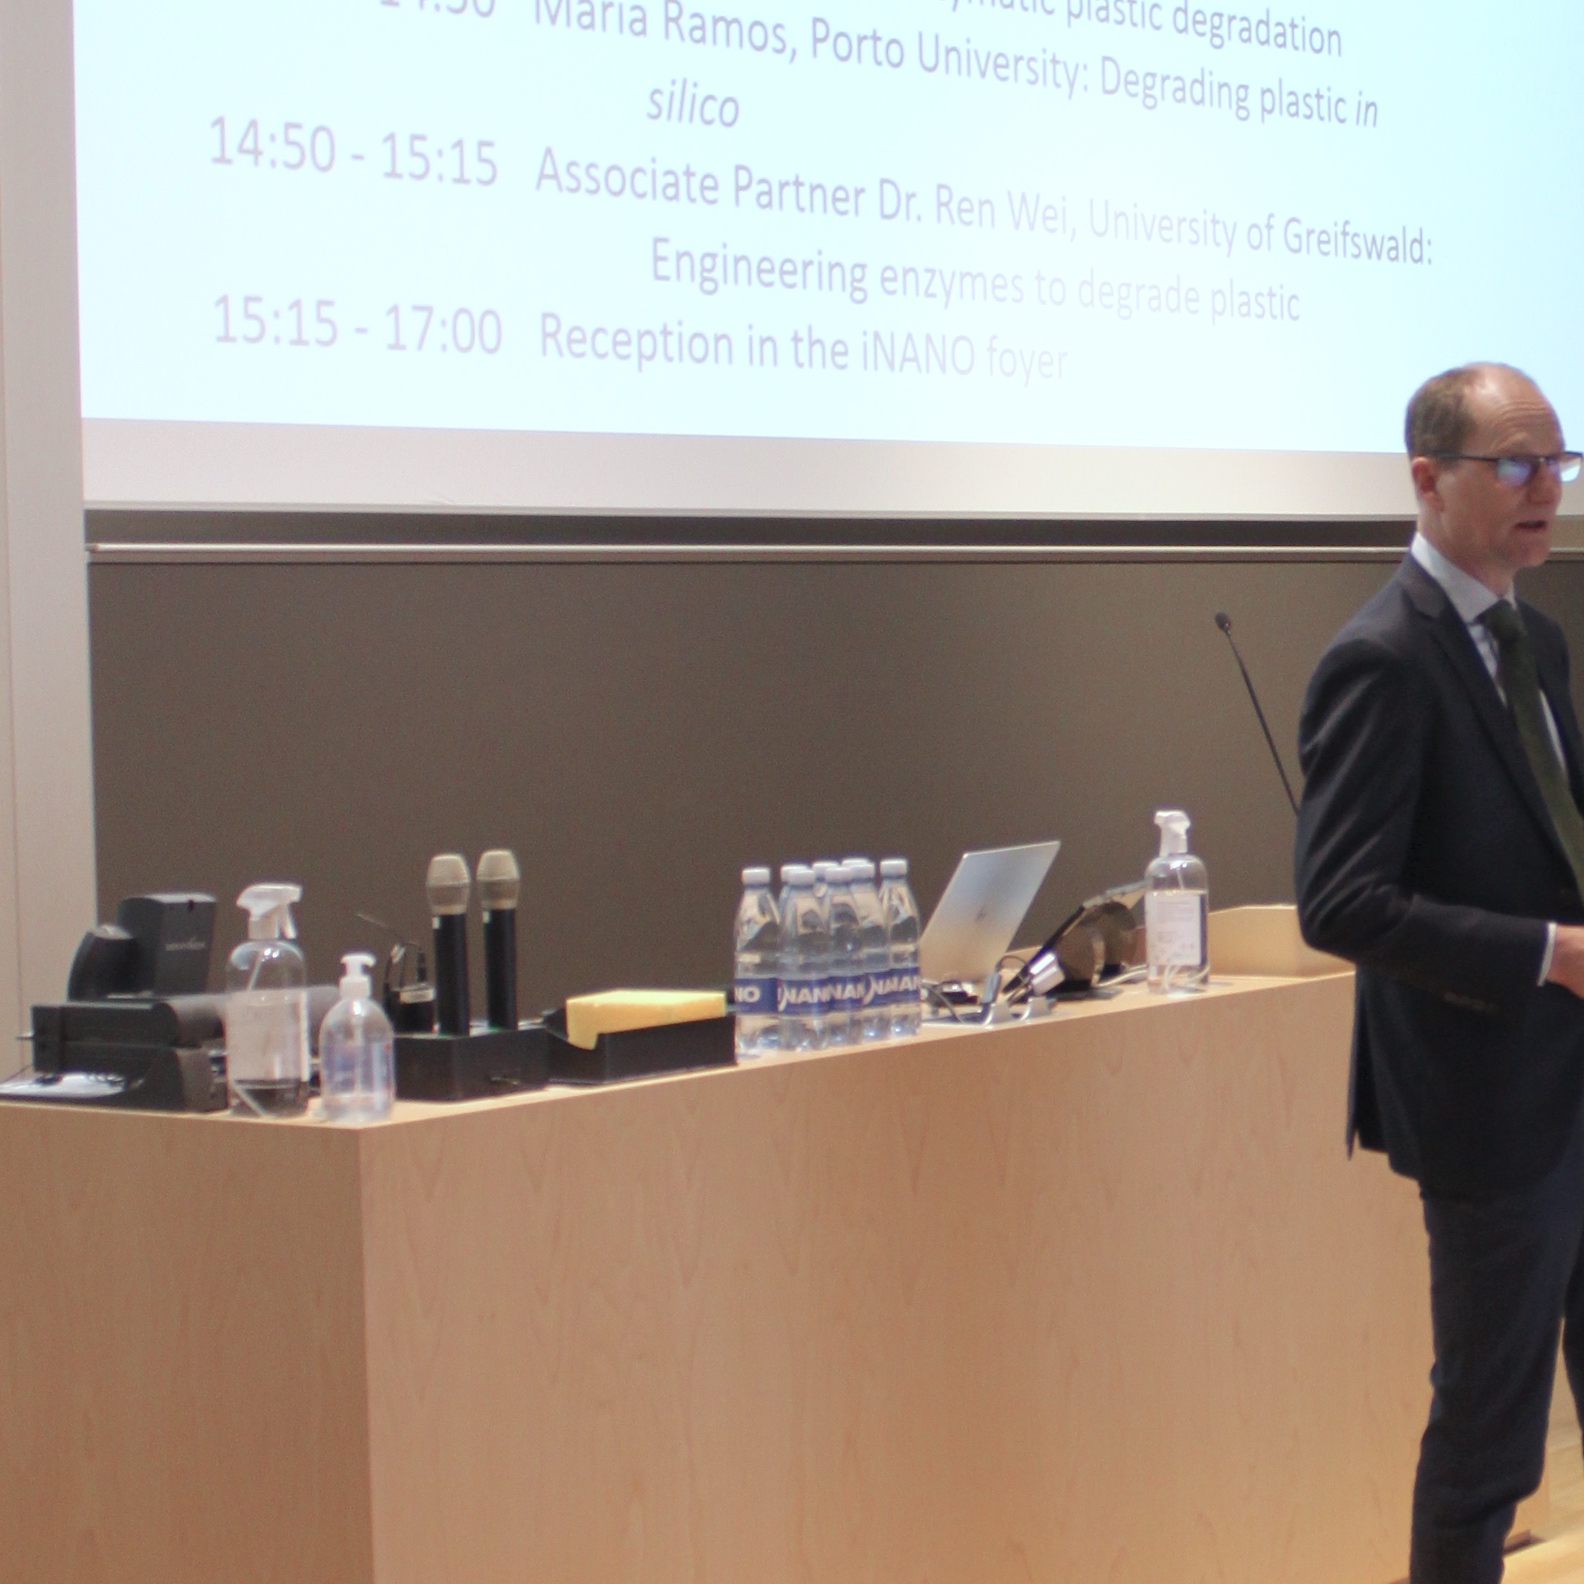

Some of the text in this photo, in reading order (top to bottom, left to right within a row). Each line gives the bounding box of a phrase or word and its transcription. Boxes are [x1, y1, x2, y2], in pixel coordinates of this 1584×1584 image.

[647, 78, 740, 128] silico
[812, 16, 905, 69] Porto
[918, 32, 1090, 99] University:
[1101, 55, 1250, 122] Degrading
[1260, 78, 1347, 124] plastic
[1356, 90, 1378, 127] in
[211, 115, 336, 173] 14:50
[383, 132, 498, 187] 15:15
[536, 146, 719, 205] Associate
[734, 164, 866, 216] Partner
[879, 177, 922, 222] Dr.
[936, 183, 995, 228] Ren
[1007, 191, 1076, 241] Wei,
[1089, 198, 1237, 257] University
[1247, 213, 1275, 251] of
[1283, 216, 1433, 264] Greifswald:
[652, 236, 1300, 324] Engineering enzymes to degrade plastic
[215, 294, 338, 347] 15:15
[386, 304, 503, 355] 17:00
[541, 311, 733, 372] Reception
[748, 324, 778, 366] in
[791, 325, 849, 370] the
[863, 330, 975, 376] iNANO
[987, 334, 1068, 387] foyer
